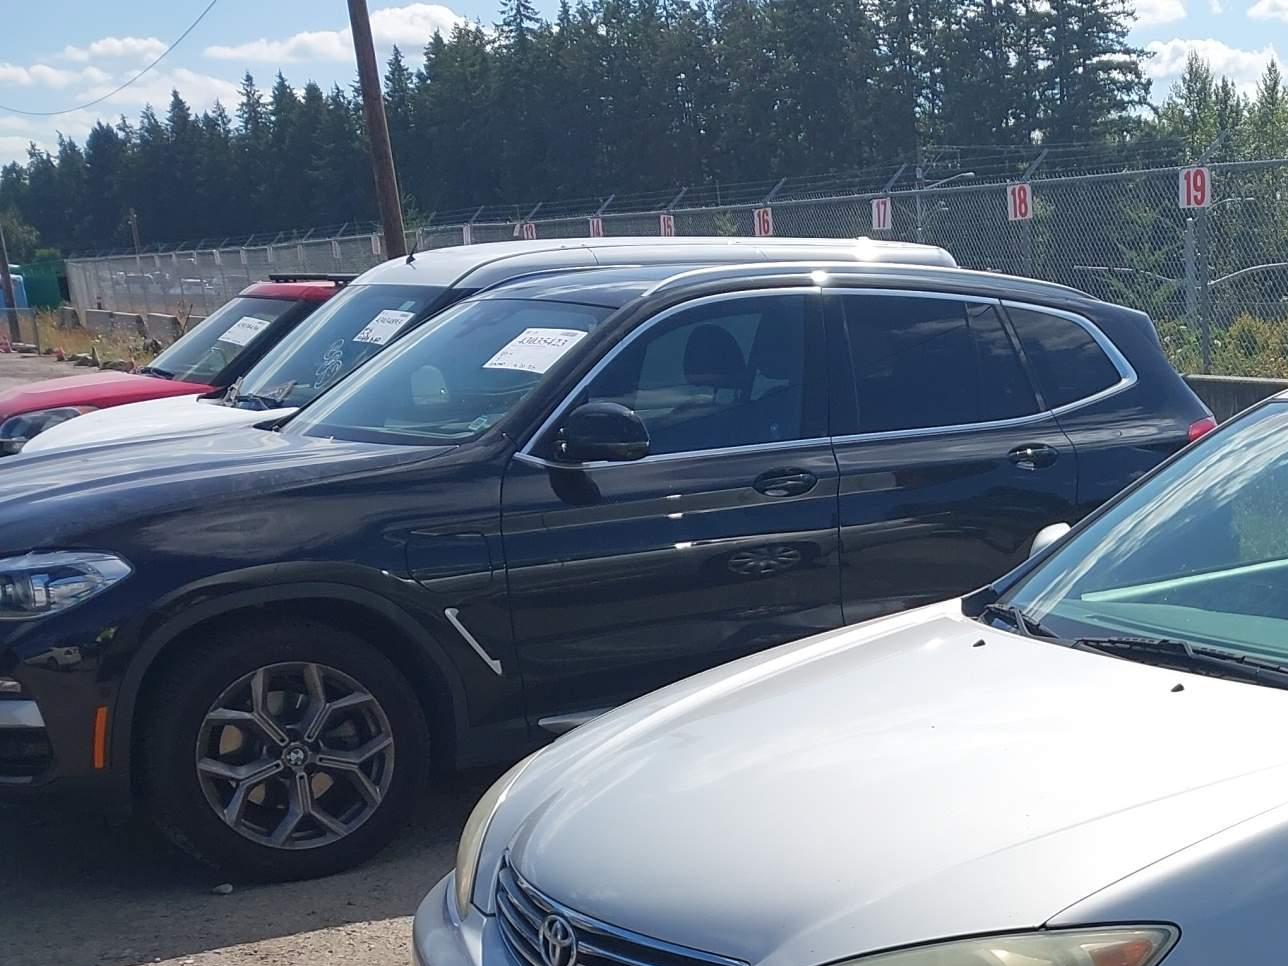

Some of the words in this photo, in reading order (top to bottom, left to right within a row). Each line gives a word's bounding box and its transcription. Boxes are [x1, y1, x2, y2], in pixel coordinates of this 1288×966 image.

[1184, 169, 1206, 206] 19
[876, 201, 887, 228] 17
[1011, 186, 1028, 218] 18
[662, 216, 673, 237] 15
[756, 209, 769, 235] 16
